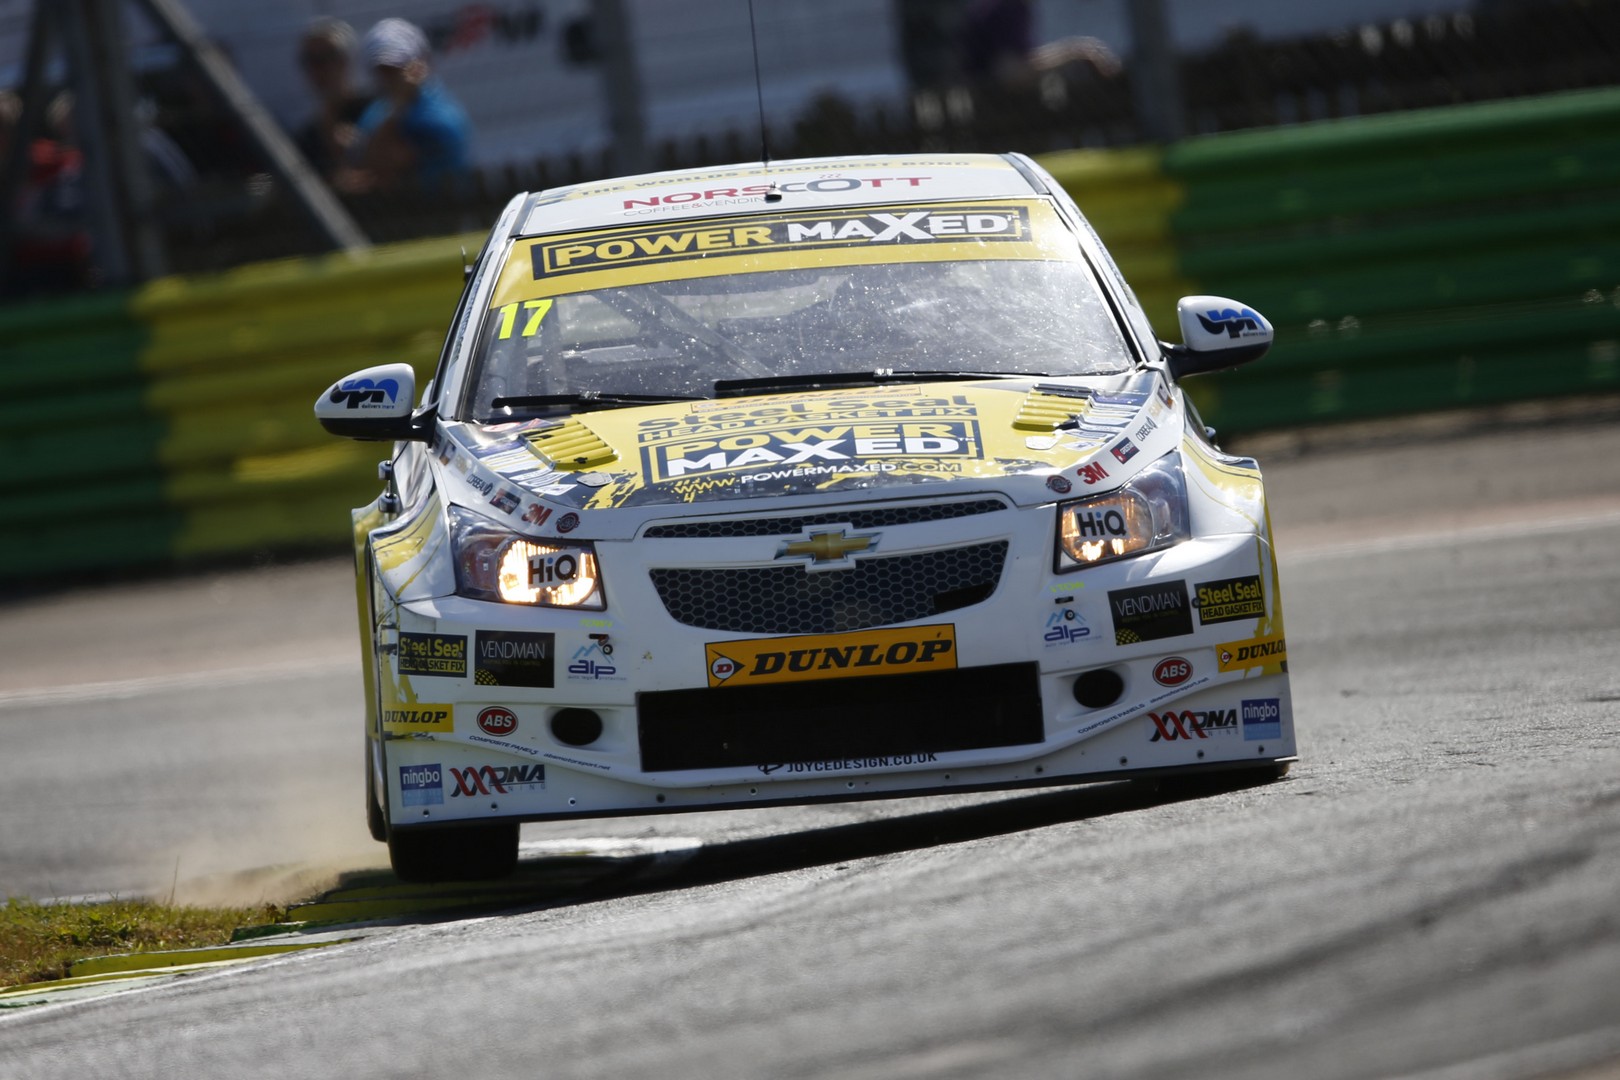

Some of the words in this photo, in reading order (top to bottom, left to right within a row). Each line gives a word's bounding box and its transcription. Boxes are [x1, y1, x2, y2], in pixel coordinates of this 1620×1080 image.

[581, 184, 625, 196] THE
[635, 171, 739, 187] WORLDS
[624, 176, 932, 210] NORSCOTT
[624, 195, 768, 217] COFFEE&VENDIN
[555, 225, 775, 267] POWER
[499, 299, 553, 339] 17
[638, 403, 813, 431] Steel
[828, 395, 975, 410] Seal
[644, 421, 747, 442] HEAD
[753, 409, 903, 426] GASKET
[911, 407, 974, 417] FIX
[665, 423, 958, 460] POWER
[1077, 461, 1110, 484] 3M
[521, 503, 553, 527] 3M
[1077, 508, 1127, 538] HiQ
[527, 552, 577, 586] HiQ
[1115, 590, 1182, 618] VENDMAN
[1199, 587, 1230, 606] Steel
[1235, 579, 1262, 600] Seal
[1202, 607, 1225, 619] HEAD
[1225, 603, 1250, 616] GASKET
[1252, 602, 1263, 613] FIX
[480, 640, 546, 660] VENDMAN
[749, 638, 953, 676] DUNLOP
[1236, 638, 1287, 662] DUNLO
[450, 661, 464, 671] FIX
[1160, 662, 1188, 680] ABS
[384, 710, 448, 724] DUNLOP
[483, 714, 513, 728] ABS
[1078, 715, 1118, 734] COMPOSITE
[1118, 703, 1146, 719] PANELS
[1190, 708, 1238, 728] DNA
[1244, 703, 1279, 722] ningbo
[469, 735, 511, 749] COMPOSITE
[489, 764, 545, 784] DNA
[786, 752, 938, 773] JOYCEDESIGN.CO.UK
[402, 769, 441, 788] ningbo
